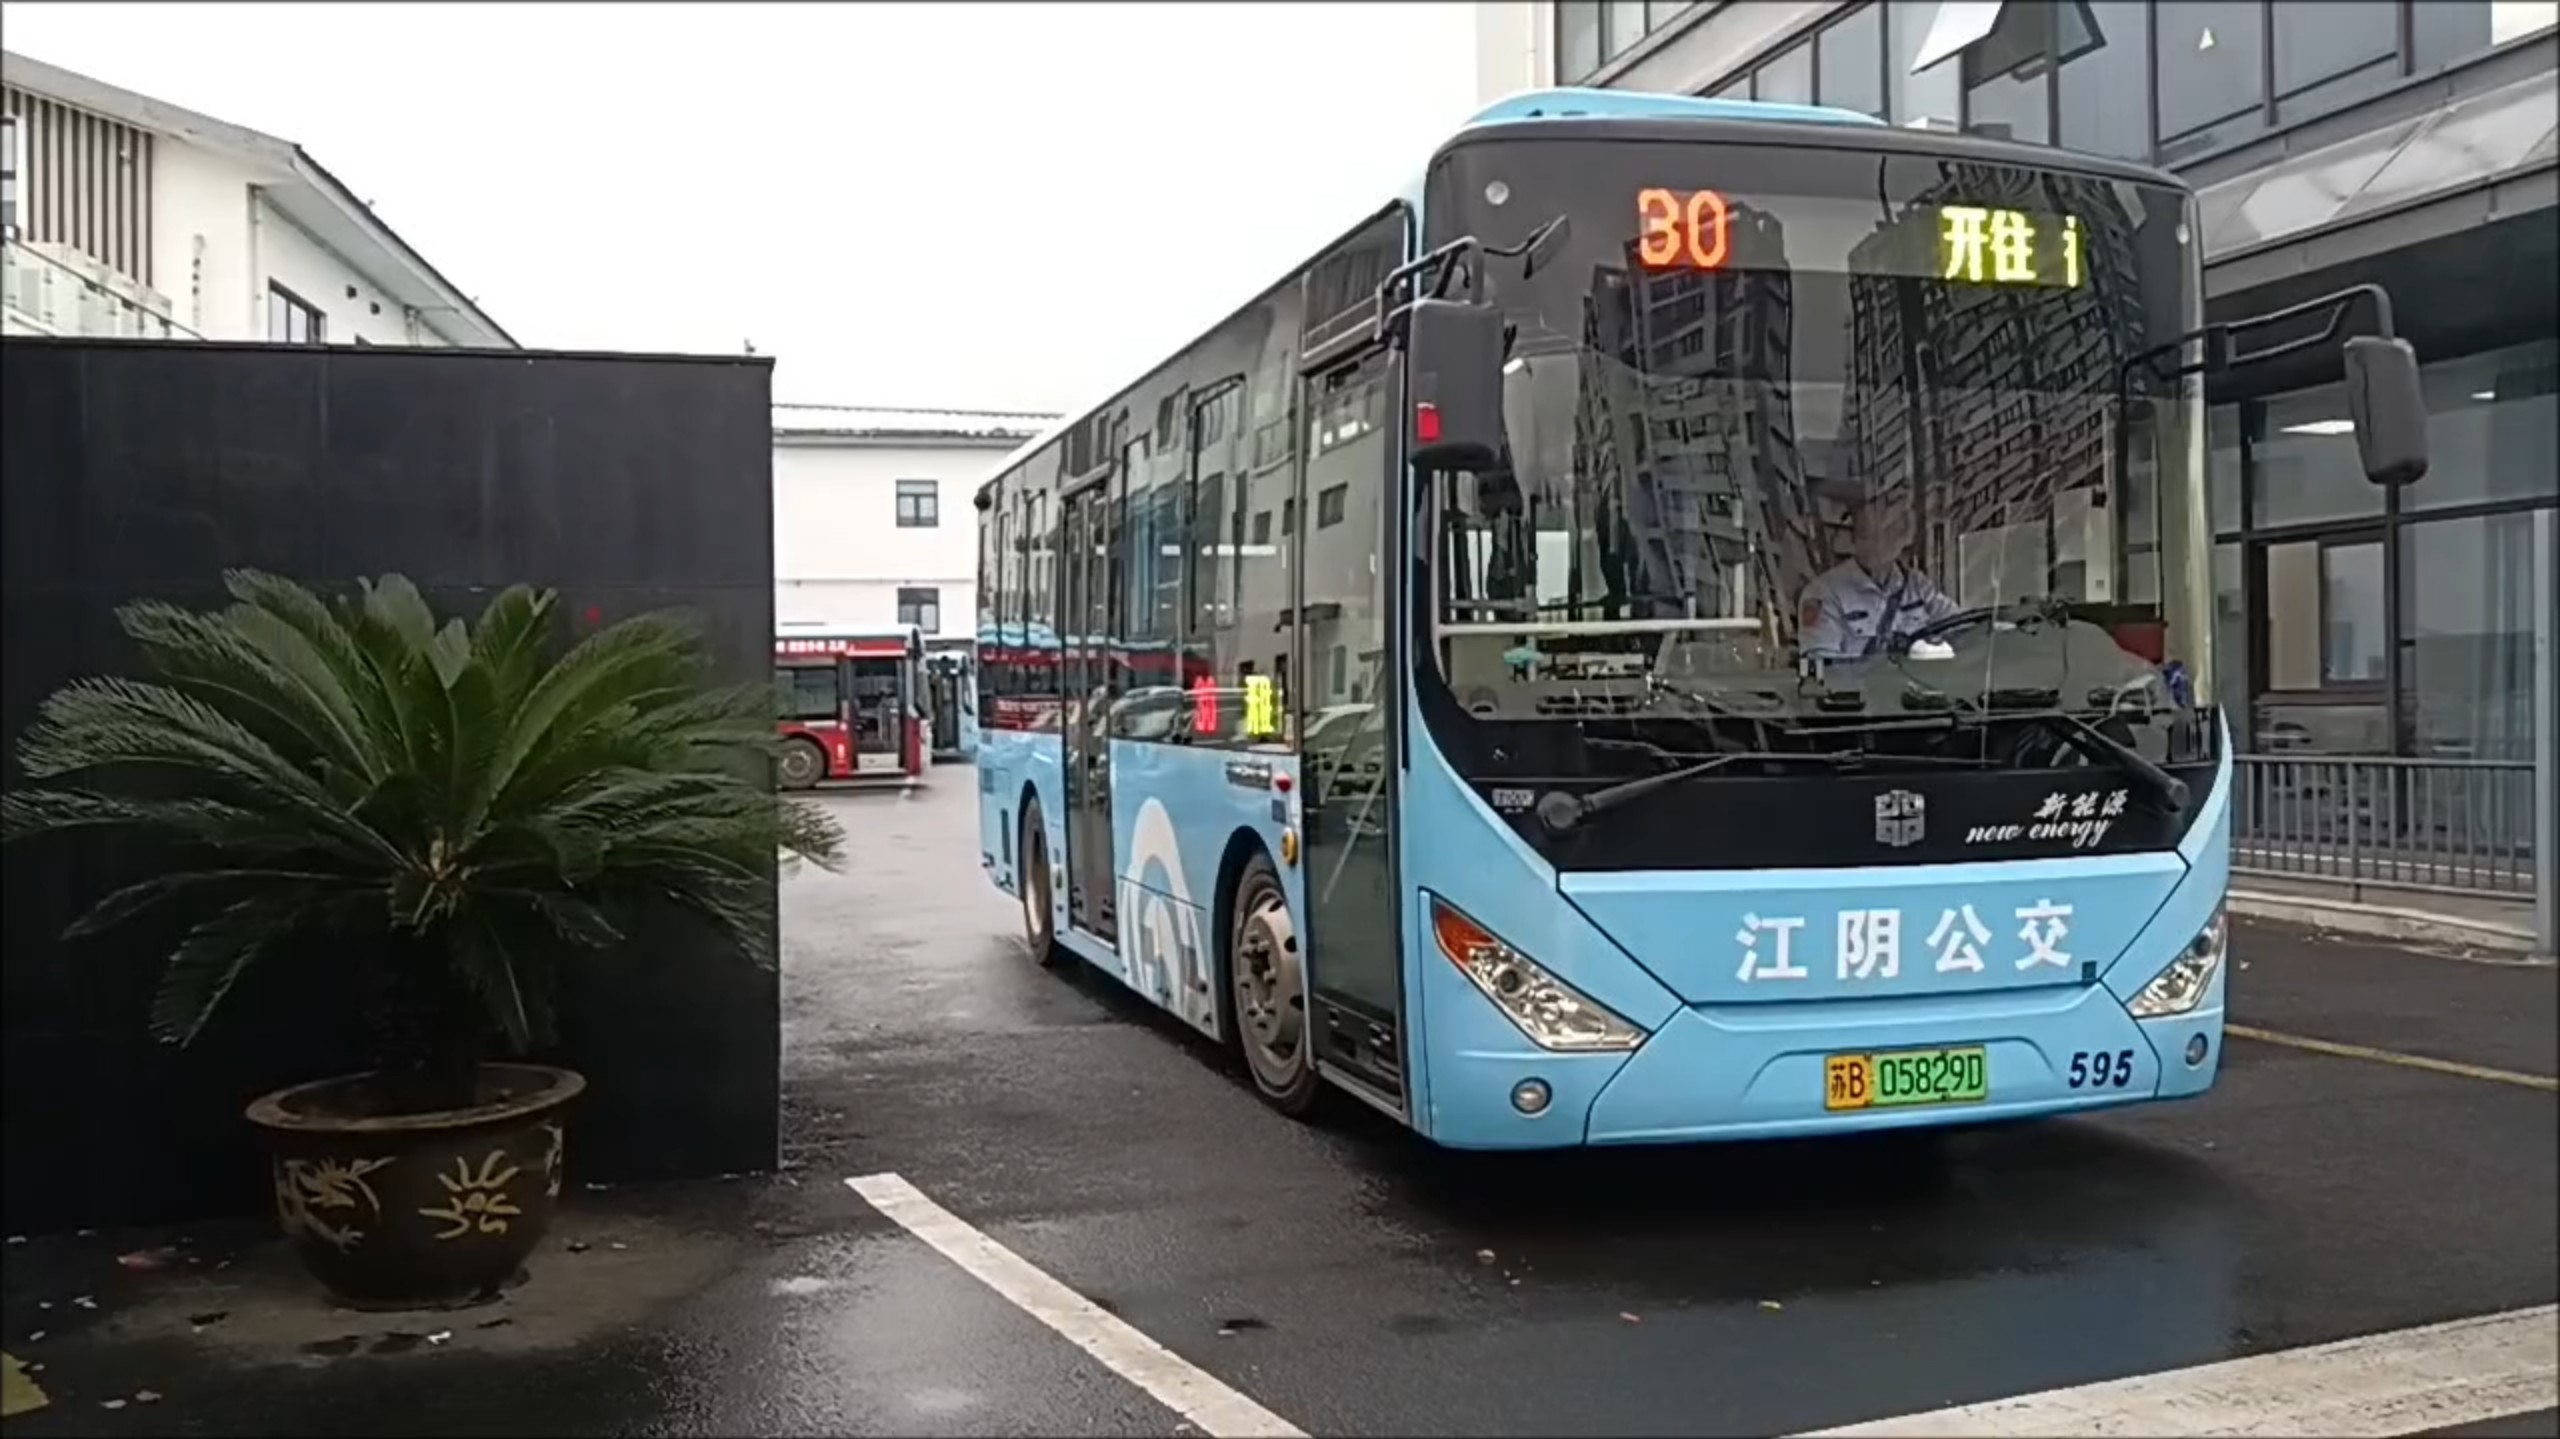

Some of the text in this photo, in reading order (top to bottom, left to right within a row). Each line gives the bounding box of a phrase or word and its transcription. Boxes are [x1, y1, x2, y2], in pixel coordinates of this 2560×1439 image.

[1638, 187, 1729, 267] 30
[2033, 788, 2129, 822] 新能源
[1965, 818, 2113, 849] new energy
[1735, 899, 2073, 983] 江阴公交
[2068, 1049, 2134, 1089] 595
